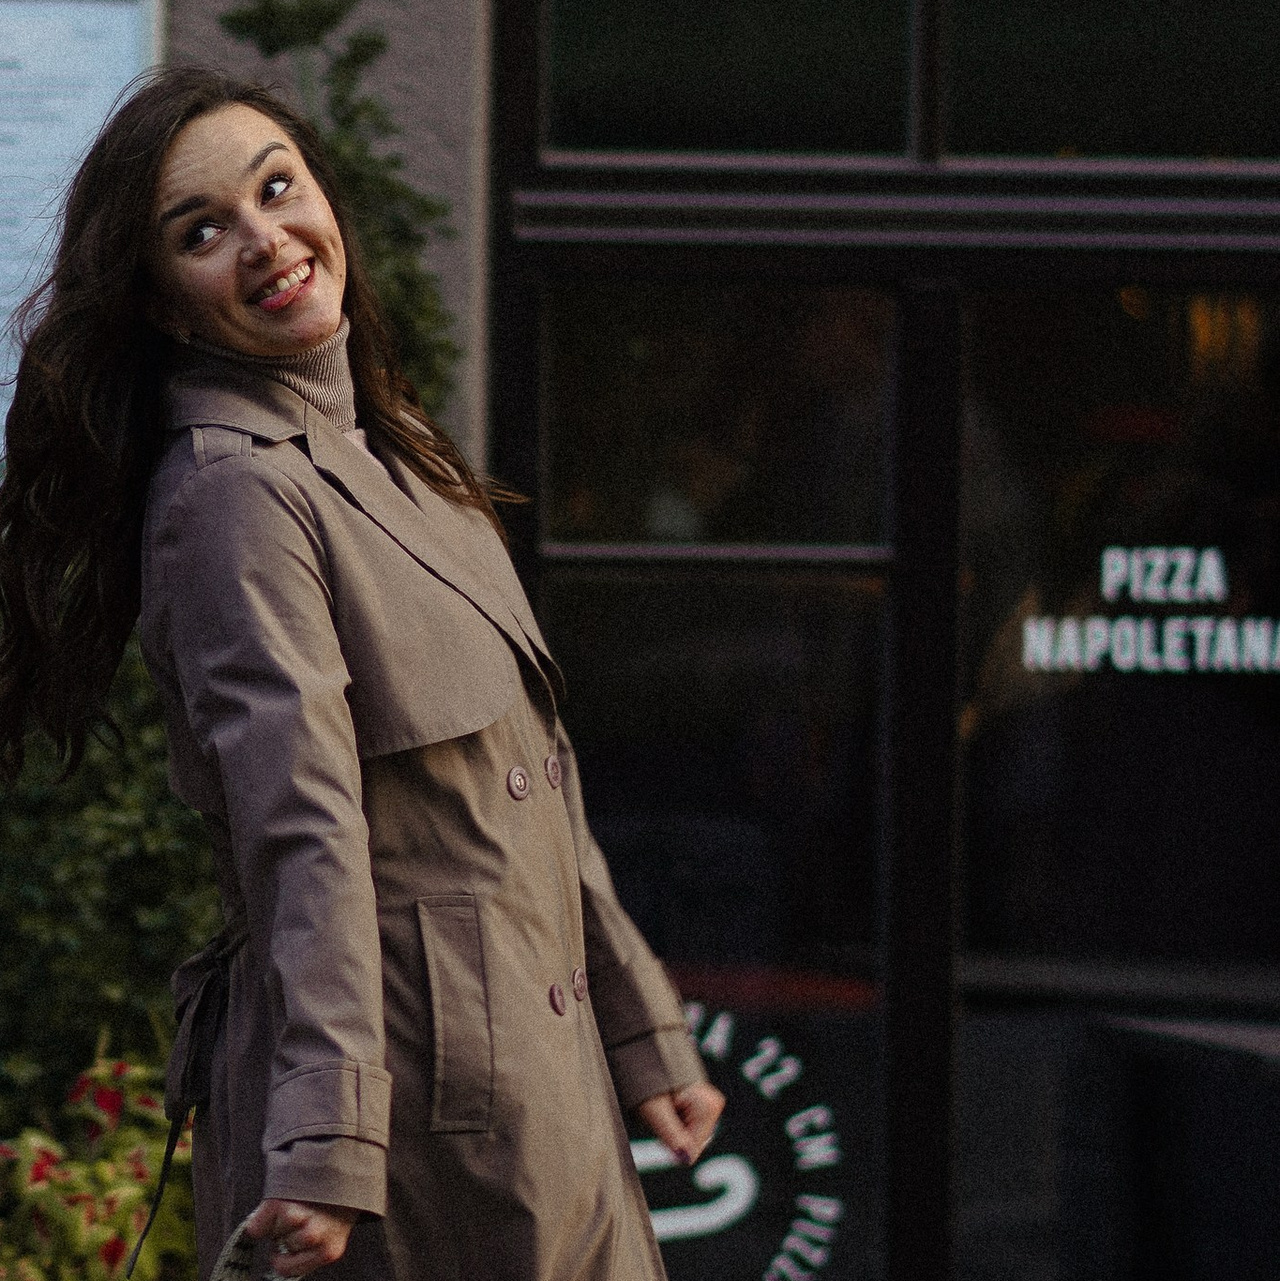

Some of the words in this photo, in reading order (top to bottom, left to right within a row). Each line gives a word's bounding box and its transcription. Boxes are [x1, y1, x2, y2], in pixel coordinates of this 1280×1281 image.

[1102, 547, 1226, 603] PIZZA
[1022, 616, 1280, 671] NAPOLETAN
[742, 1037, 800, 1096] 22
[786, 1106, 838, 1168] CM
